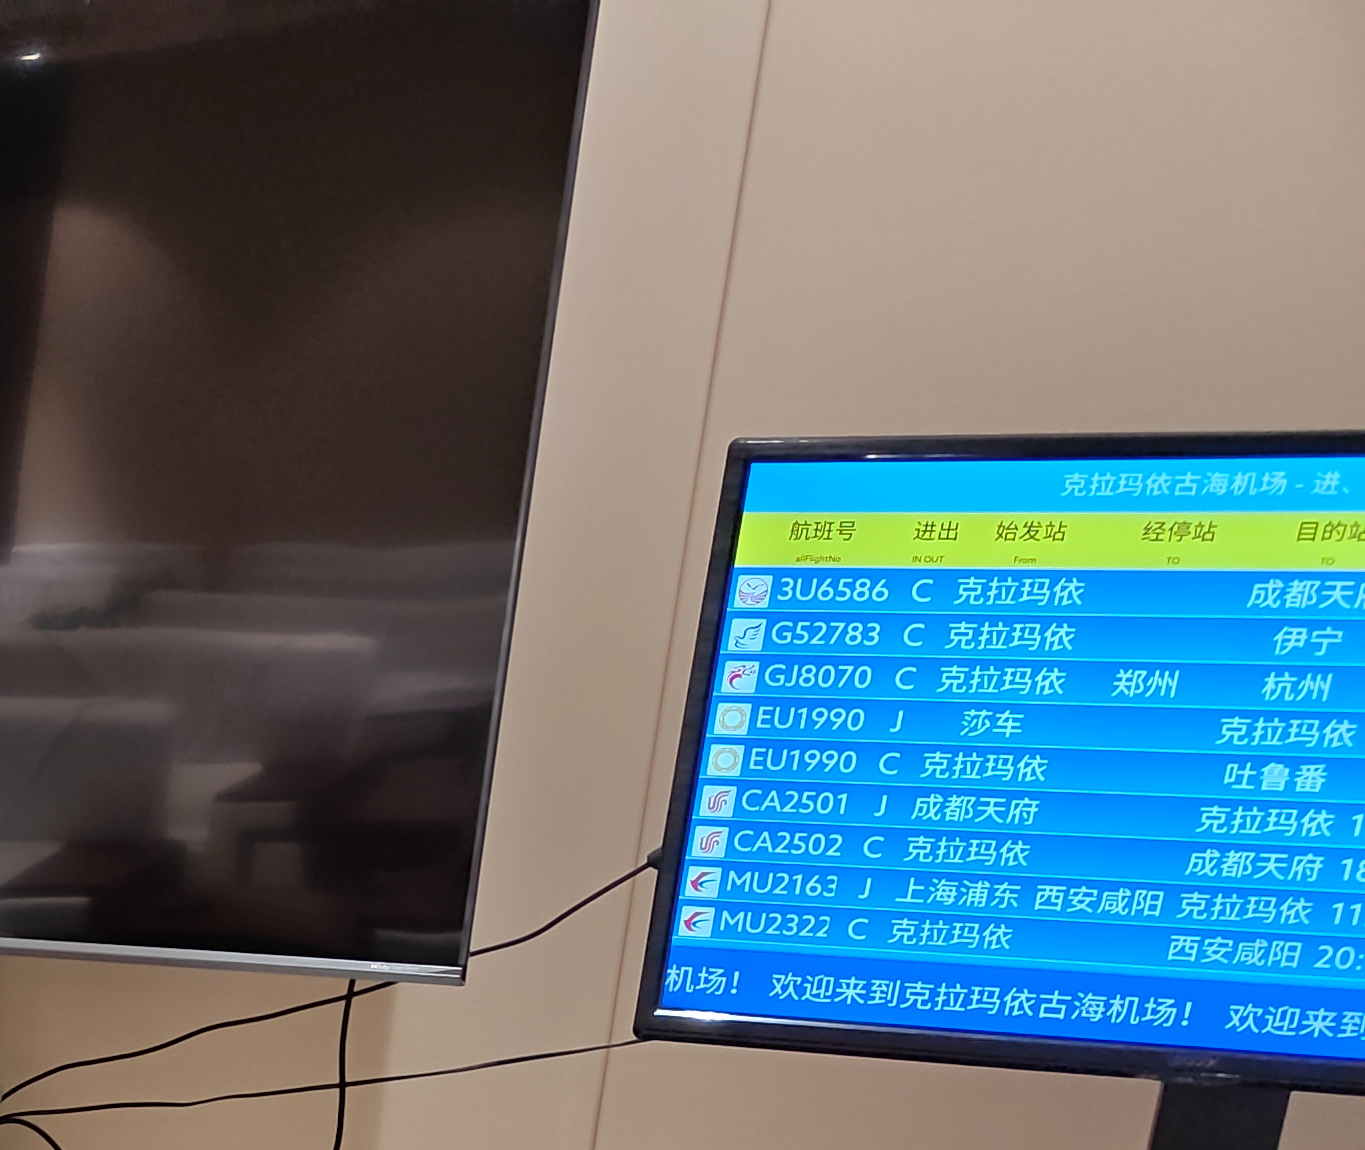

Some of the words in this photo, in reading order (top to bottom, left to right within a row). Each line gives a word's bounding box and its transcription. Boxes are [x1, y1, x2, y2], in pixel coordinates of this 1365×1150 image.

[1060, 471, 1287, 497] 克拉玛依古海机场
[788, 520, 857, 541] 航班号
[913, 520, 960, 542] 进出
[994, 520, 1068, 542] 始发站
[1140, 520, 1218, 543] 经停站
[1013, 555, 1037, 564] From
[1166, 556, 1180, 565] TO
[777, 577, 889, 602] 3U6586
[911, 579, 934, 603] C
[952, 576, 1086, 607] 克拉玛依
[771, 621, 881, 647] G52783
[902, 623, 925, 648] C
[944, 620, 1077, 652] 克拉玛依
[1272, 626, 1344, 656] 伊宁
[764, 664, 873, 688] GJ8070
[894, 666, 917, 691] C
[935, 664, 1067, 696] 克拉玛依
[1111, 668, 1180, 699] 郑州
[1261, 671, 1333, 702] 杭州
[756, 706, 865, 732] EU1990
[889, 710, 904, 733] J
[959, 708, 1025, 739] 莎车
[1215, 715, 1358, 748] 克拉玛依
[748, 747, 857, 773] EU1990
[879, 752, 901, 775] C
[919, 751, 1049, 783] 克拉玛依
[1223, 762, 1329, 793] 吐鲁番
[741, 789, 848, 815] CA2501
[873, 795, 888, 818] J
[911, 793, 1041, 826] 成都天府
[1195, 804, 1336, 838] 克拉玛依
[733, 830, 843, 857] CA2502
[863, 836, 886, 859] C
[902, 834, 1032, 868] 克拉玛依
[1185, 848, 1325, 882] 成都天府
[726, 870, 839, 898] MU2163
[858, 877, 872, 900] J
[895, 876, 1022, 909] 上海浦东
[1034, 884, 1165, 918] 西安咸阳
[1176, 892, 1314, 925] 克拉玛依
[1331, 902, 1365, 926] 11
[719, 911, 831, 939] MU2322
[848, 918, 869, 941] C
[887, 918, 1014, 951] 克拉玛依
[1167, 935, 1303, 968] 西安咸阳
[665, 964, 741, 996] 机场！
[769, 972, 1193, 1027] 欢迎来到克拉玛依古海机场！
[1225, 1003, 1365, 1041] 欢迎来到
